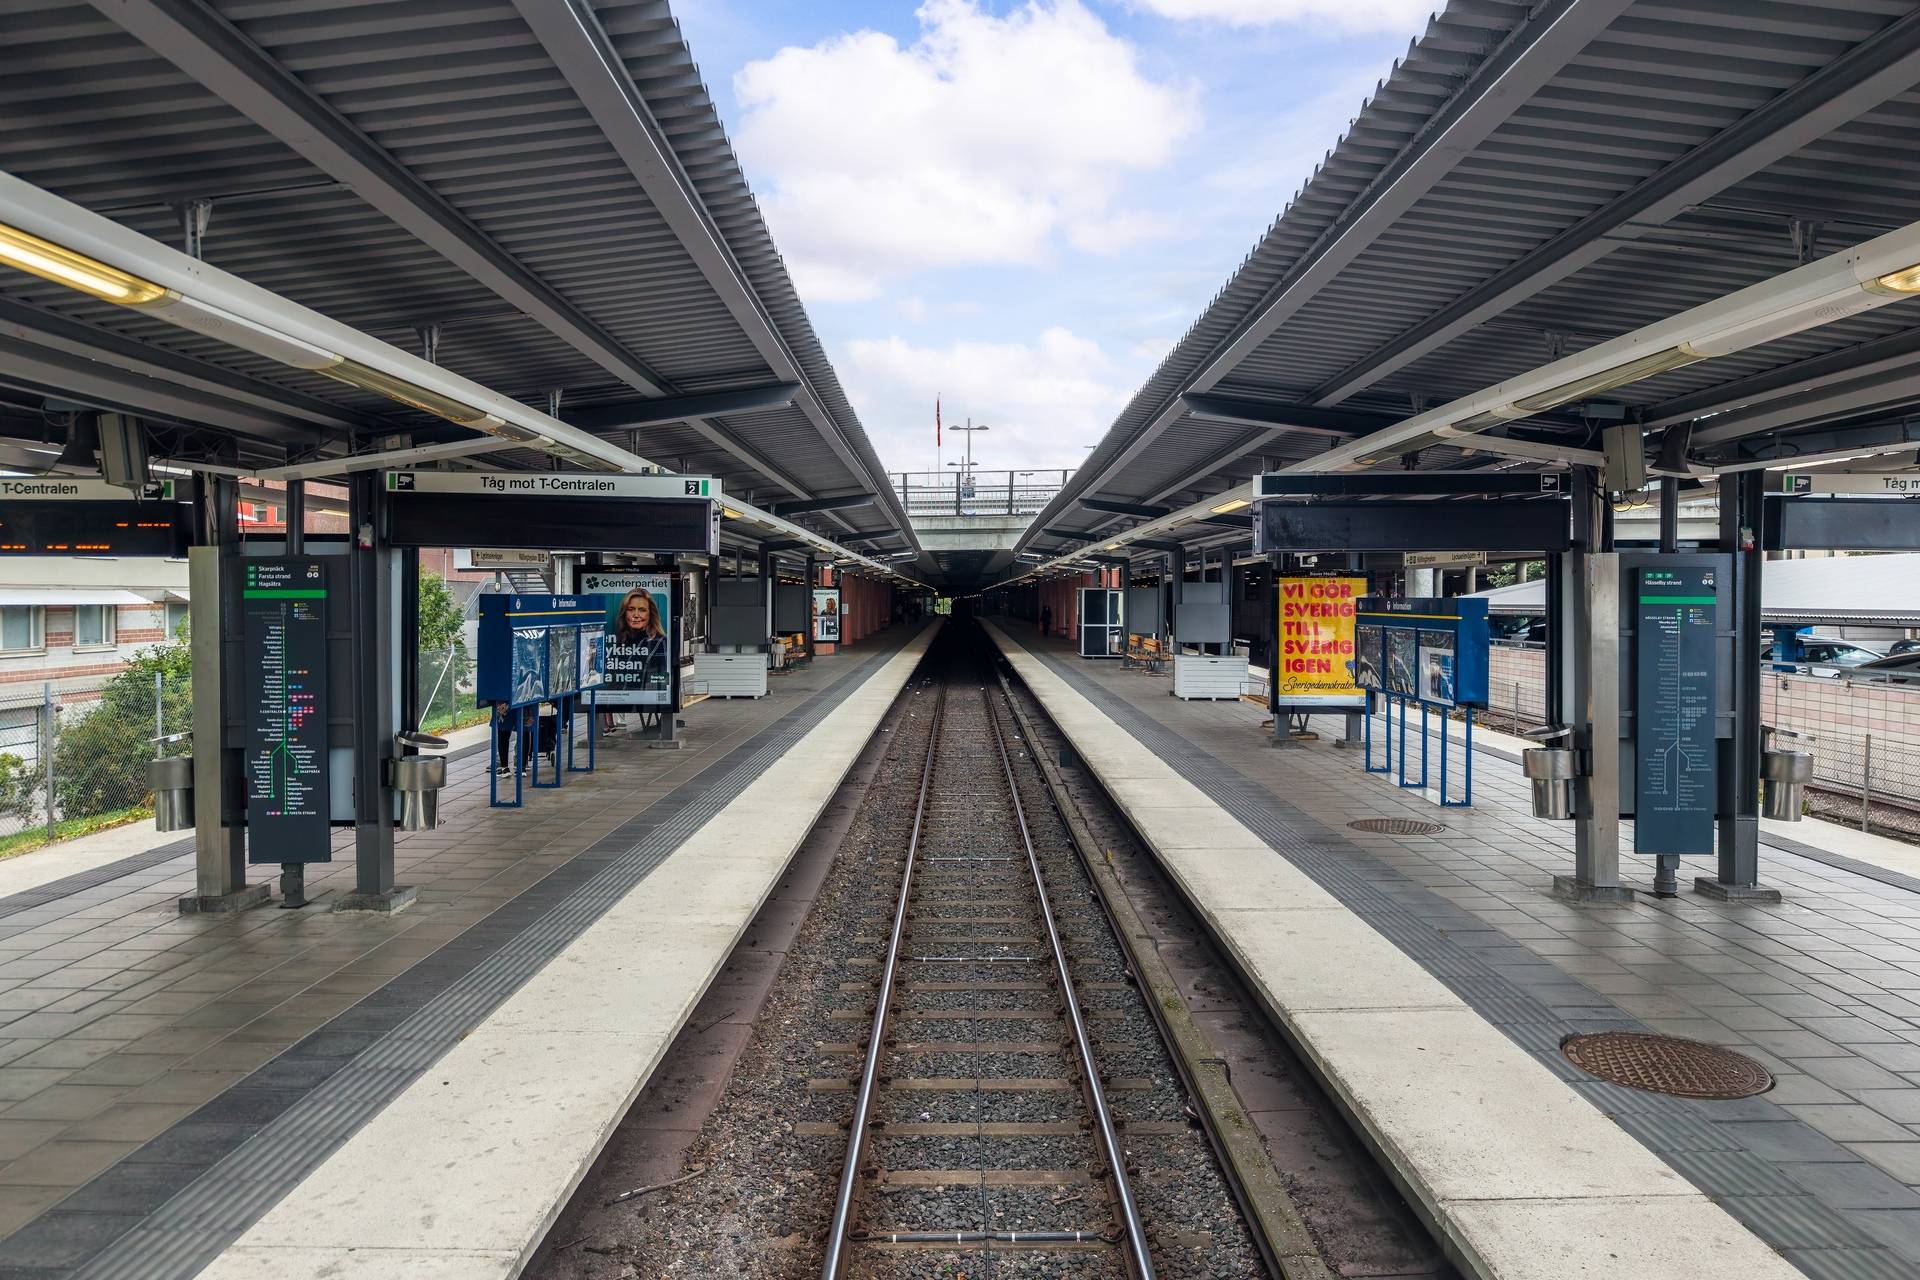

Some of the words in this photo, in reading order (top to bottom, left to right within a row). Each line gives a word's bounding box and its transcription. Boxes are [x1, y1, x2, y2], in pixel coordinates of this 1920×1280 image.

[3, 483, 78, 494] T-Centralen
[480, 476, 505, 491] Tåg
[509, 478, 535, 489] mot
[539, 478, 615, 491] T-Centralen
[688, 485, 696, 494] 2
[1883, 477, 1906, 491] Tåg
[601, 578, 668, 588] Centerpartiet
[1283, 583, 1304, 599] VI
[1310, 580, 1352, 599] GÖR
[559, 600, 576, 608] Information
[1283, 621, 1320, 636] TILL
[1284, 640, 1353, 655] SVERIG
[605, 658, 643, 670] älsan
[1285, 658, 1331, 673] IGEN
[615, 673, 641, 683] ner.
